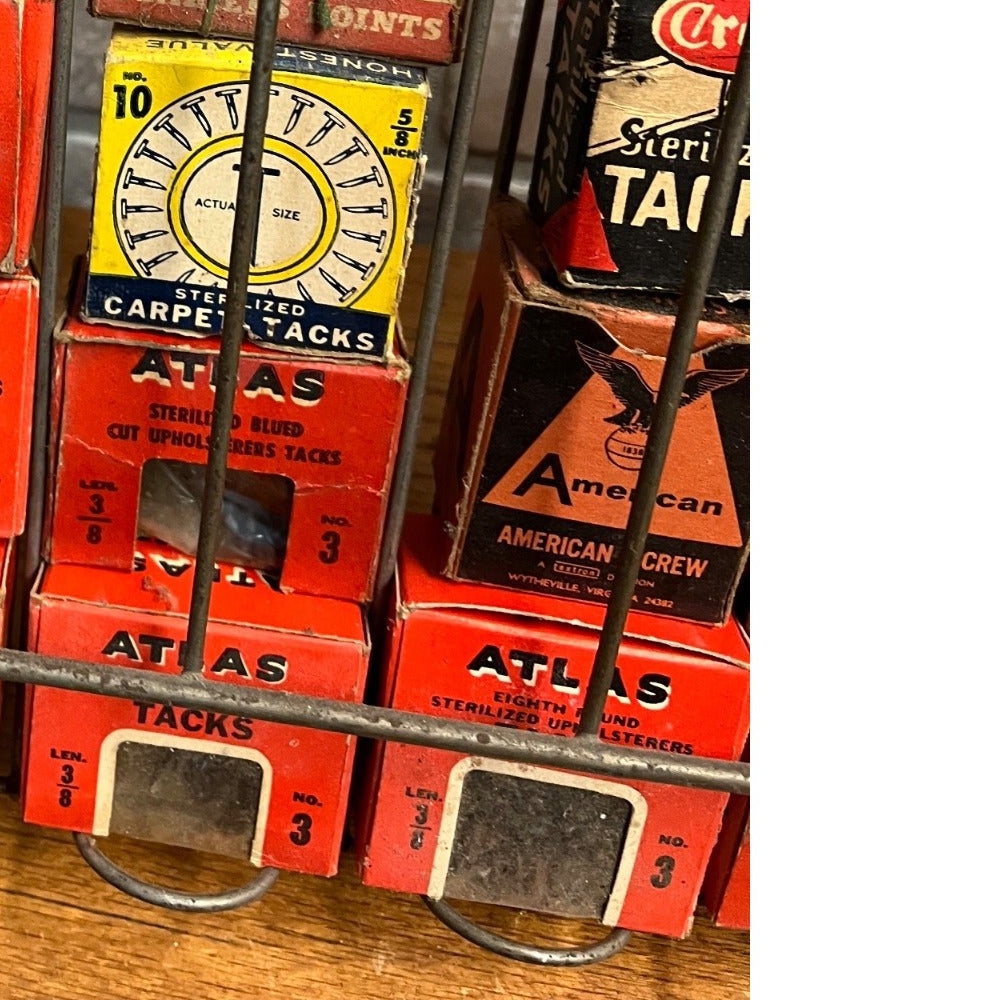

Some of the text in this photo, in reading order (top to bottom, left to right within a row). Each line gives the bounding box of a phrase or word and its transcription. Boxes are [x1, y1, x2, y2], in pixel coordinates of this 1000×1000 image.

[311, 1, 443, 41] OINTS
[669, 1, 749, 51] Cr
[146, 38, 413, 80] HONEST VALUE
[122, 71, 147, 83] NO.
[112, 84, 153, 119] 10
[398, 107, 414, 126] 5
[194, 197, 301, 222] ACTUA SIZE
[175, 287, 306, 317] STERIZED
[262, 316, 376, 352] TACKS
[130, 350, 326, 408] ATAS
[148, 402, 305, 438] STERILID BLUED
[106, 422, 342, 466] CUT UPHOLERERS TACKS
[511, 452, 724, 517] Amecan
[88, 493, 105, 515] 3
[318, 530, 341, 564] 3
[496, 524, 709, 578] AMERICAN CREW
[586, 585, 639, 603] VIRGA
[132, 701, 255, 741] TACKS
[430, 694, 540, 726] STERILIZED
[549, 716, 695, 756] UPLSTERERS
[492, 690, 567, 715] EIGHTH
[575, 706, 640, 730] PUND
[50, 748, 87, 763] LEN.
[60, 764, 75, 785] 3
[292, 791, 323, 807] NO.
[404, 786, 443, 803] LEN.
[289, 812, 313, 847] 3
[657, 834, 689, 849] NO.
[649, 855, 676, 890] 3
